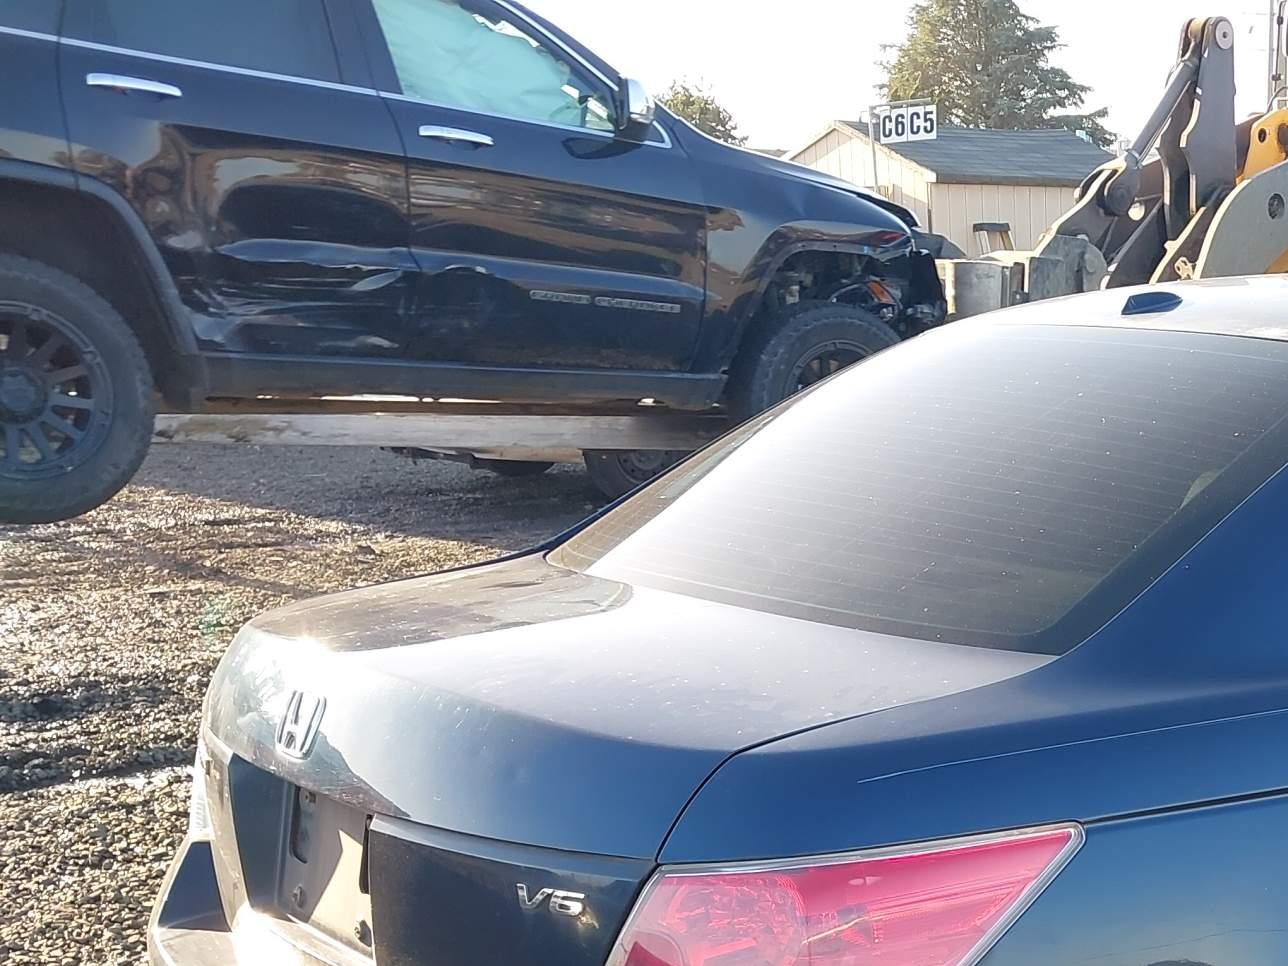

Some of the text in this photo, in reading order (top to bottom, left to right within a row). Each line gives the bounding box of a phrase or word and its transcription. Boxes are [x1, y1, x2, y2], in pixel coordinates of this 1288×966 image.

[882, 111, 934, 138] C6 C5
[516, 883, 585, 917] V6
